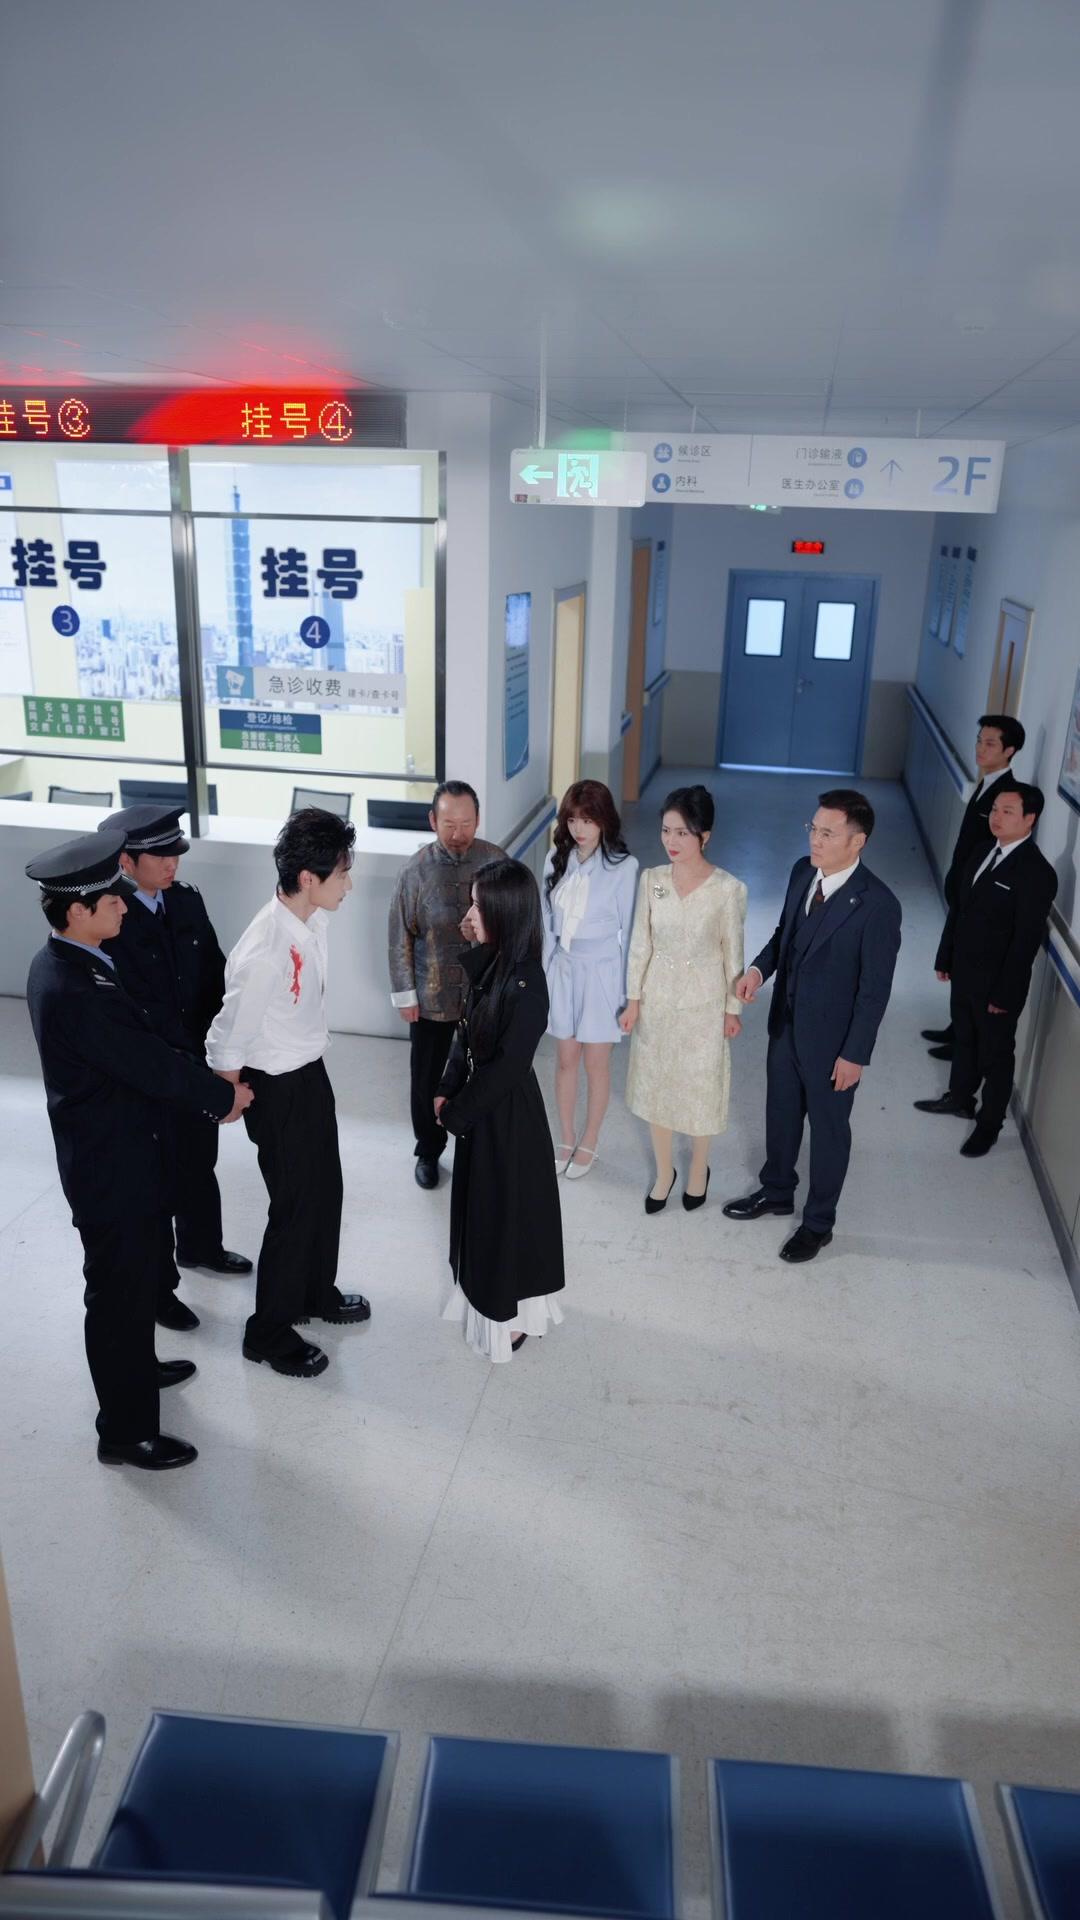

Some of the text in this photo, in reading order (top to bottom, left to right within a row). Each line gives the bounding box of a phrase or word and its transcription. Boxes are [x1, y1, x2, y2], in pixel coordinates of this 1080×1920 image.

[678, 445, 712, 457] 候诊区
[794, 447, 843, 460] 门诊输液
[675, 476, 697, 487] 内科
[781, 478, 841, 491] 医生办公室
[932, 456, 992, 496] 2F
[11, 538, 107, 590] 挂号
[261, 547, 363, 600] 挂号
[268, 674, 342, 698] 急诊收费
